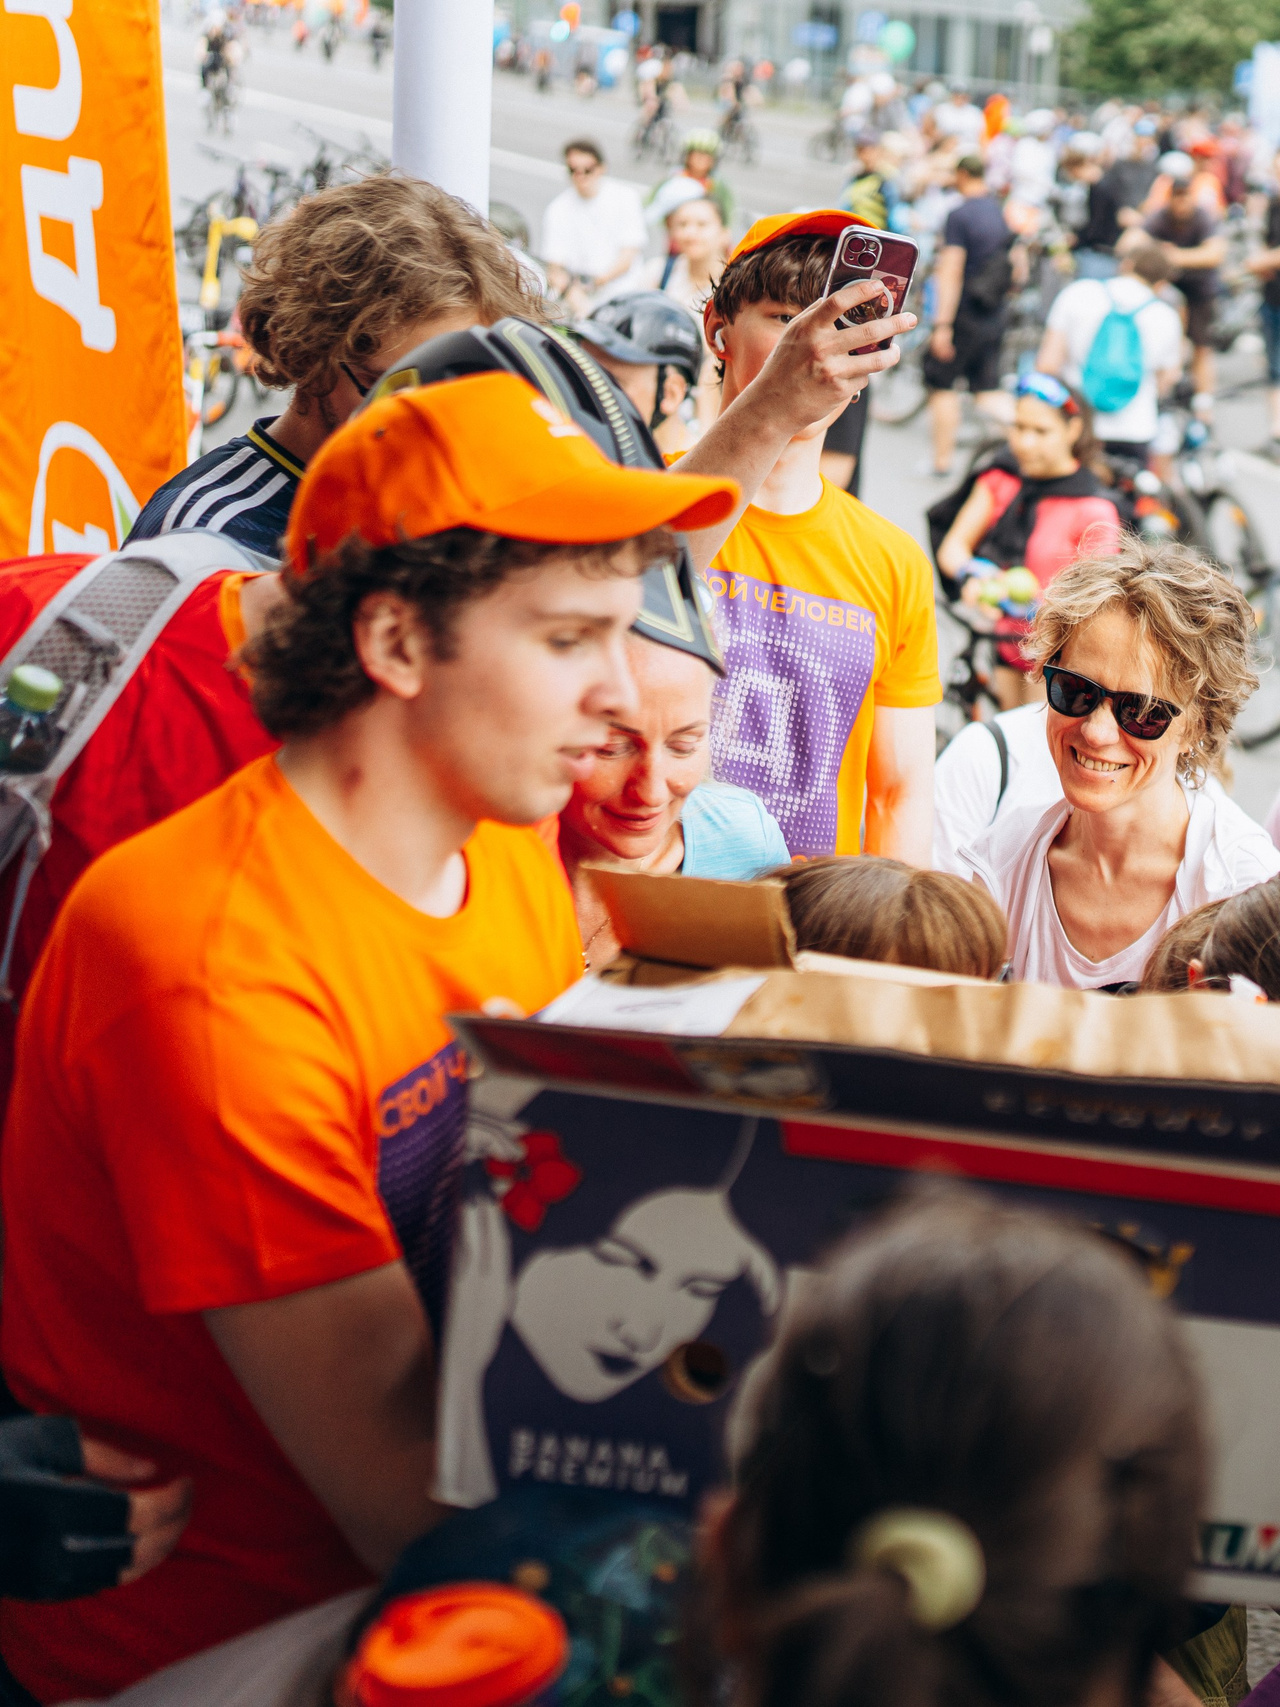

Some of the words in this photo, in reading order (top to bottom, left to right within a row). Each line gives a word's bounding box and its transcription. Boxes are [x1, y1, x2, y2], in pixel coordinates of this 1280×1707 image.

[703, 573, 748, 602] ОЙ
[754, 585, 873, 636] ЧЕЛОВЕК
[509, 1428, 671, 1472] BANANA
[508, 1455, 690, 1497] PREMIUM
